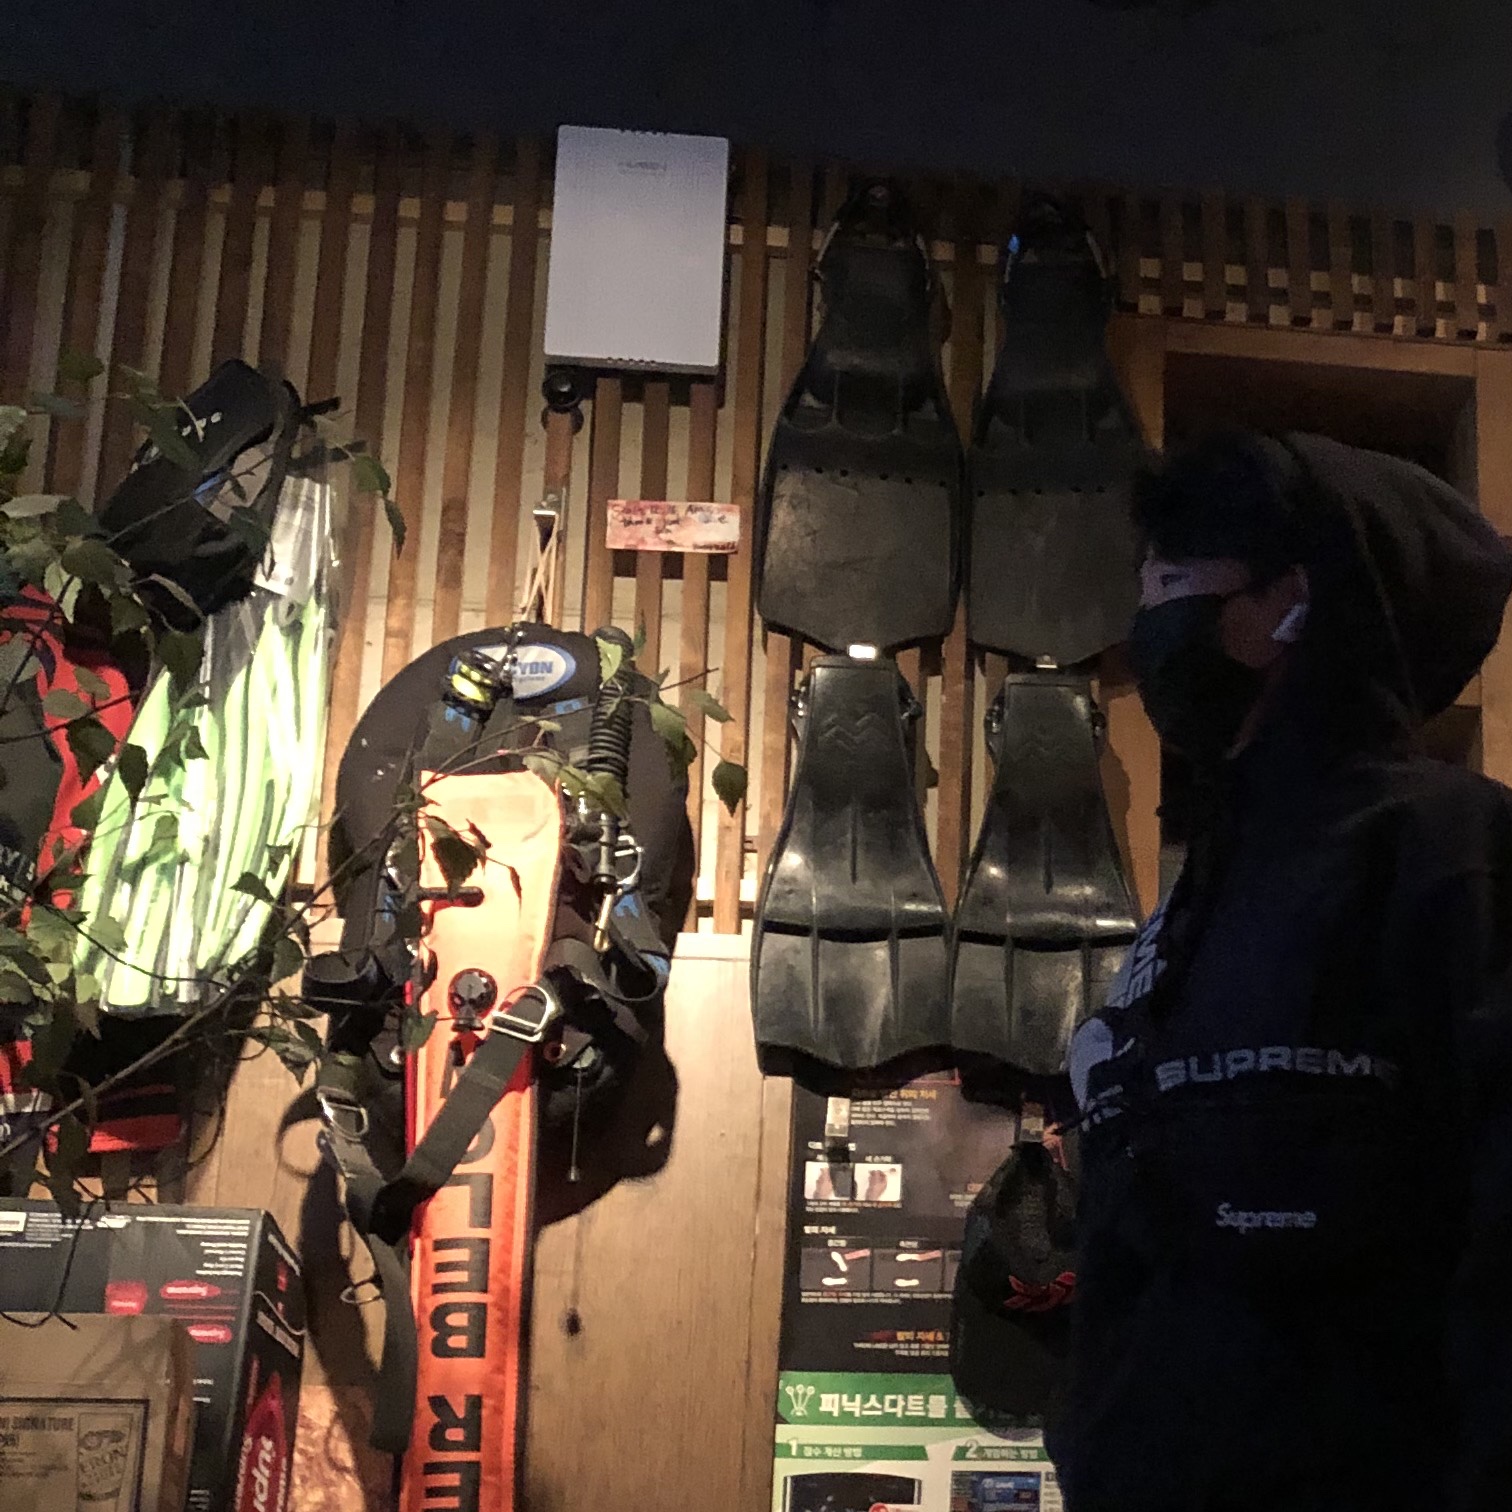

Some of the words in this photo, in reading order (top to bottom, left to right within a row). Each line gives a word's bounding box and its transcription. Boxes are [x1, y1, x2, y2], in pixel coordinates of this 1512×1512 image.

[1215, 1201, 1319, 1235] Supreme
[819, 1392, 948, 1419] 피닉스다트를
[964, 1440, 978, 1459] 2
